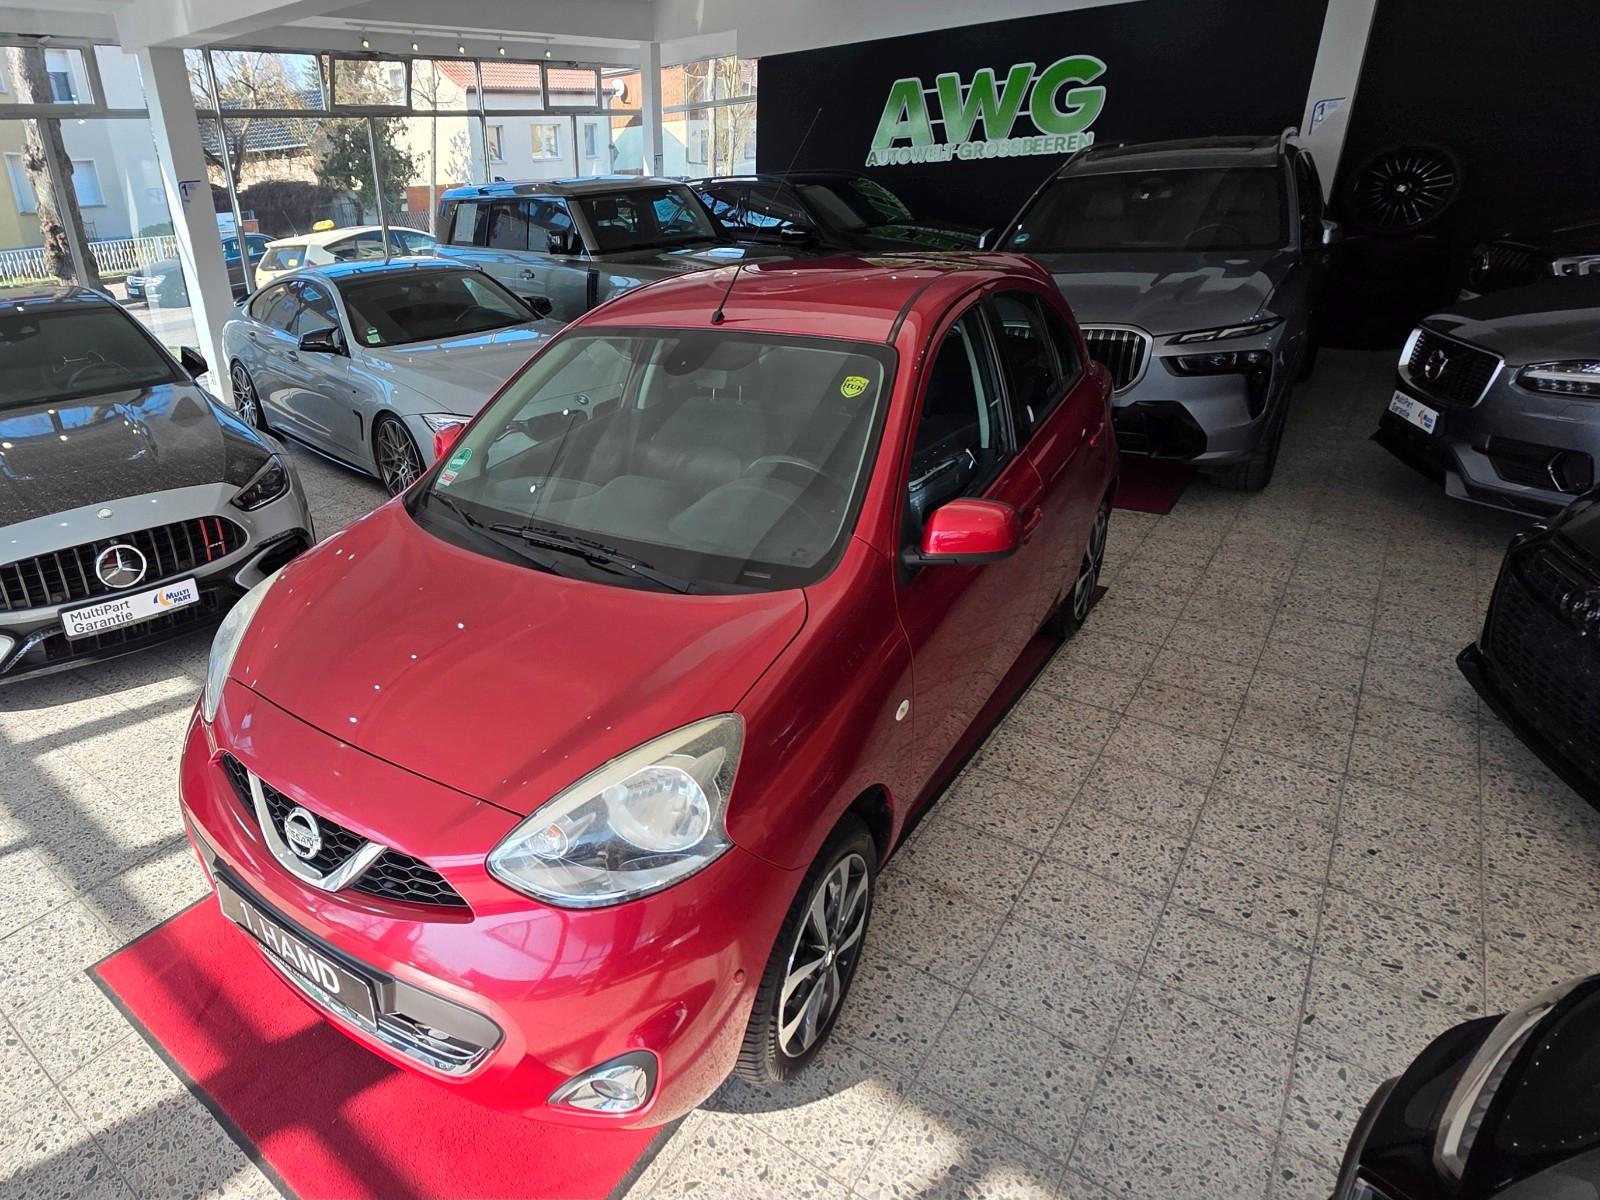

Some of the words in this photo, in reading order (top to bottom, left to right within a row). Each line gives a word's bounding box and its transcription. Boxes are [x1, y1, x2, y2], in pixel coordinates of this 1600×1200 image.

[871, 55, 1107, 151] AWG
[865, 143, 954, 167] AUTOWELT
[957, 132, 1095, 161] GROSSBEEREN
[173, 594, 192, 604] PART
[70, 600, 131, 623] MultiPart
[73, 612, 134, 633] Garantie
